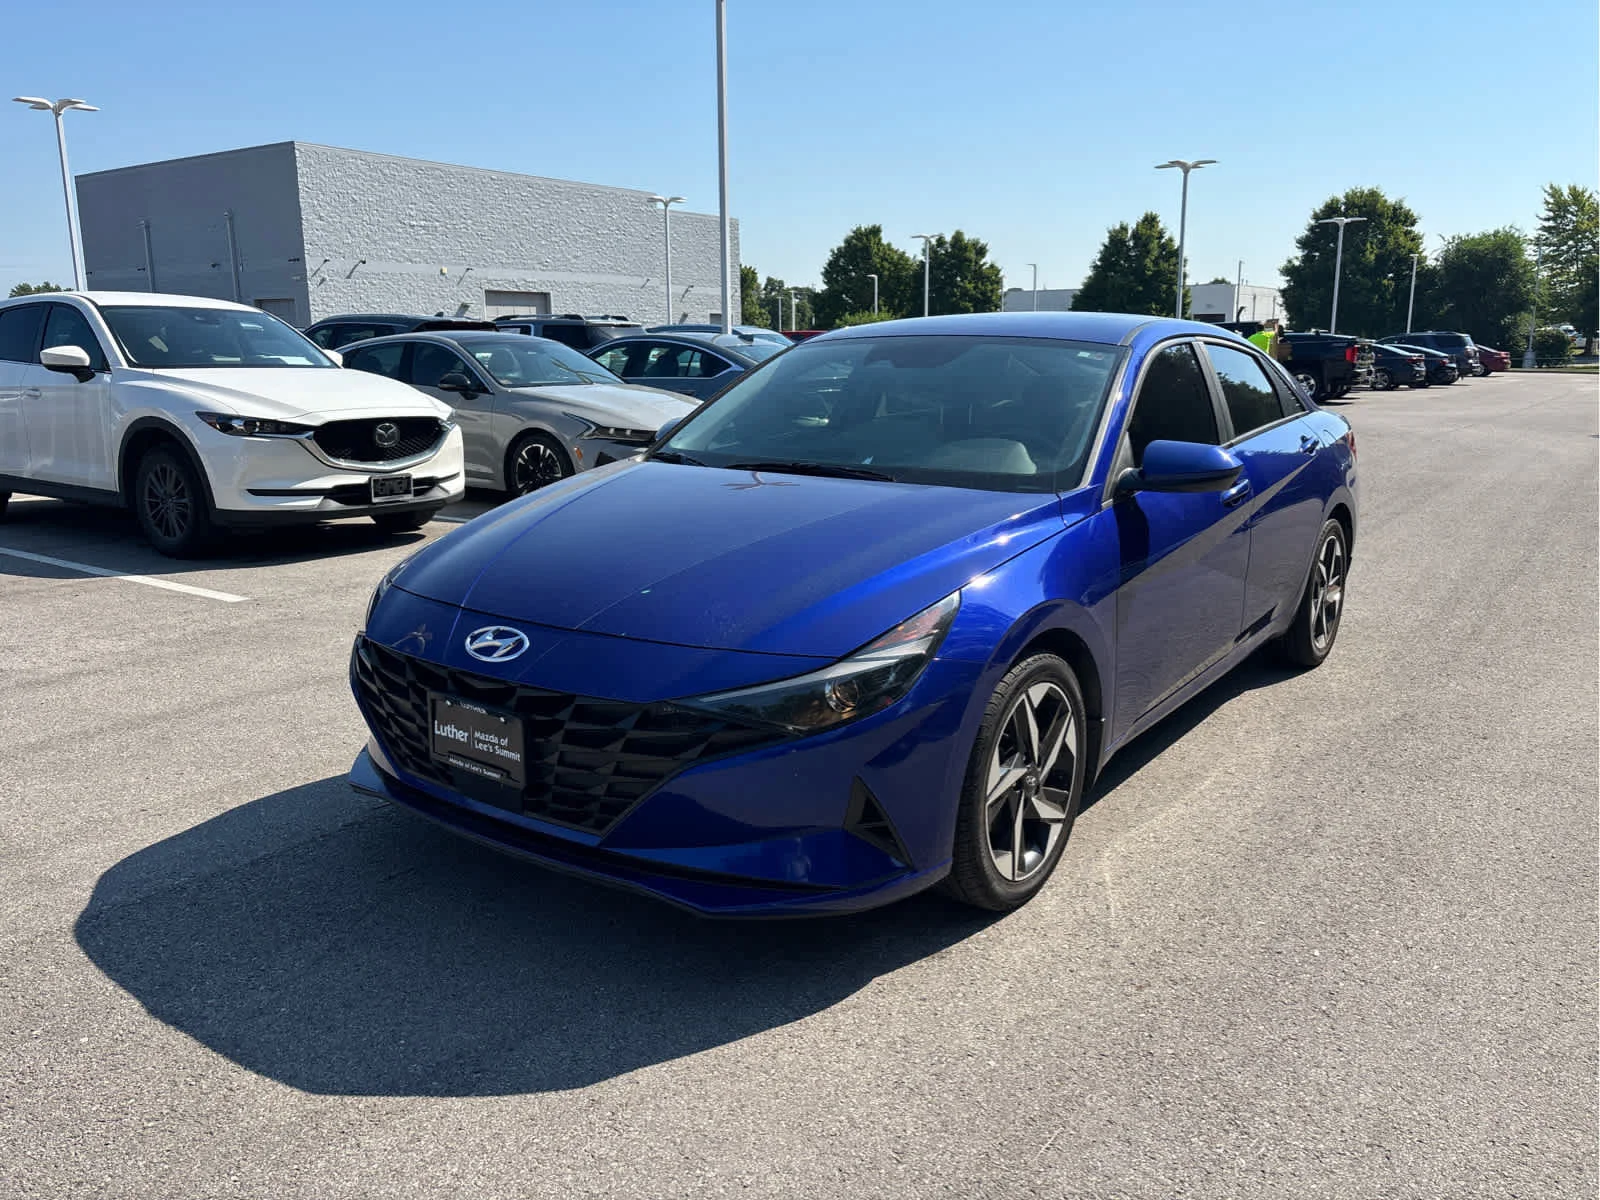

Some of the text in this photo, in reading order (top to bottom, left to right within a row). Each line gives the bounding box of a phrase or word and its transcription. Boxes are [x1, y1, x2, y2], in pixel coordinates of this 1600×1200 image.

[434, 719, 469, 742] Luther
[474, 730, 509, 746] Mazda of
[474, 740, 520, 762] Lee's Summit
[449, 757, 464, 767] Mazda
